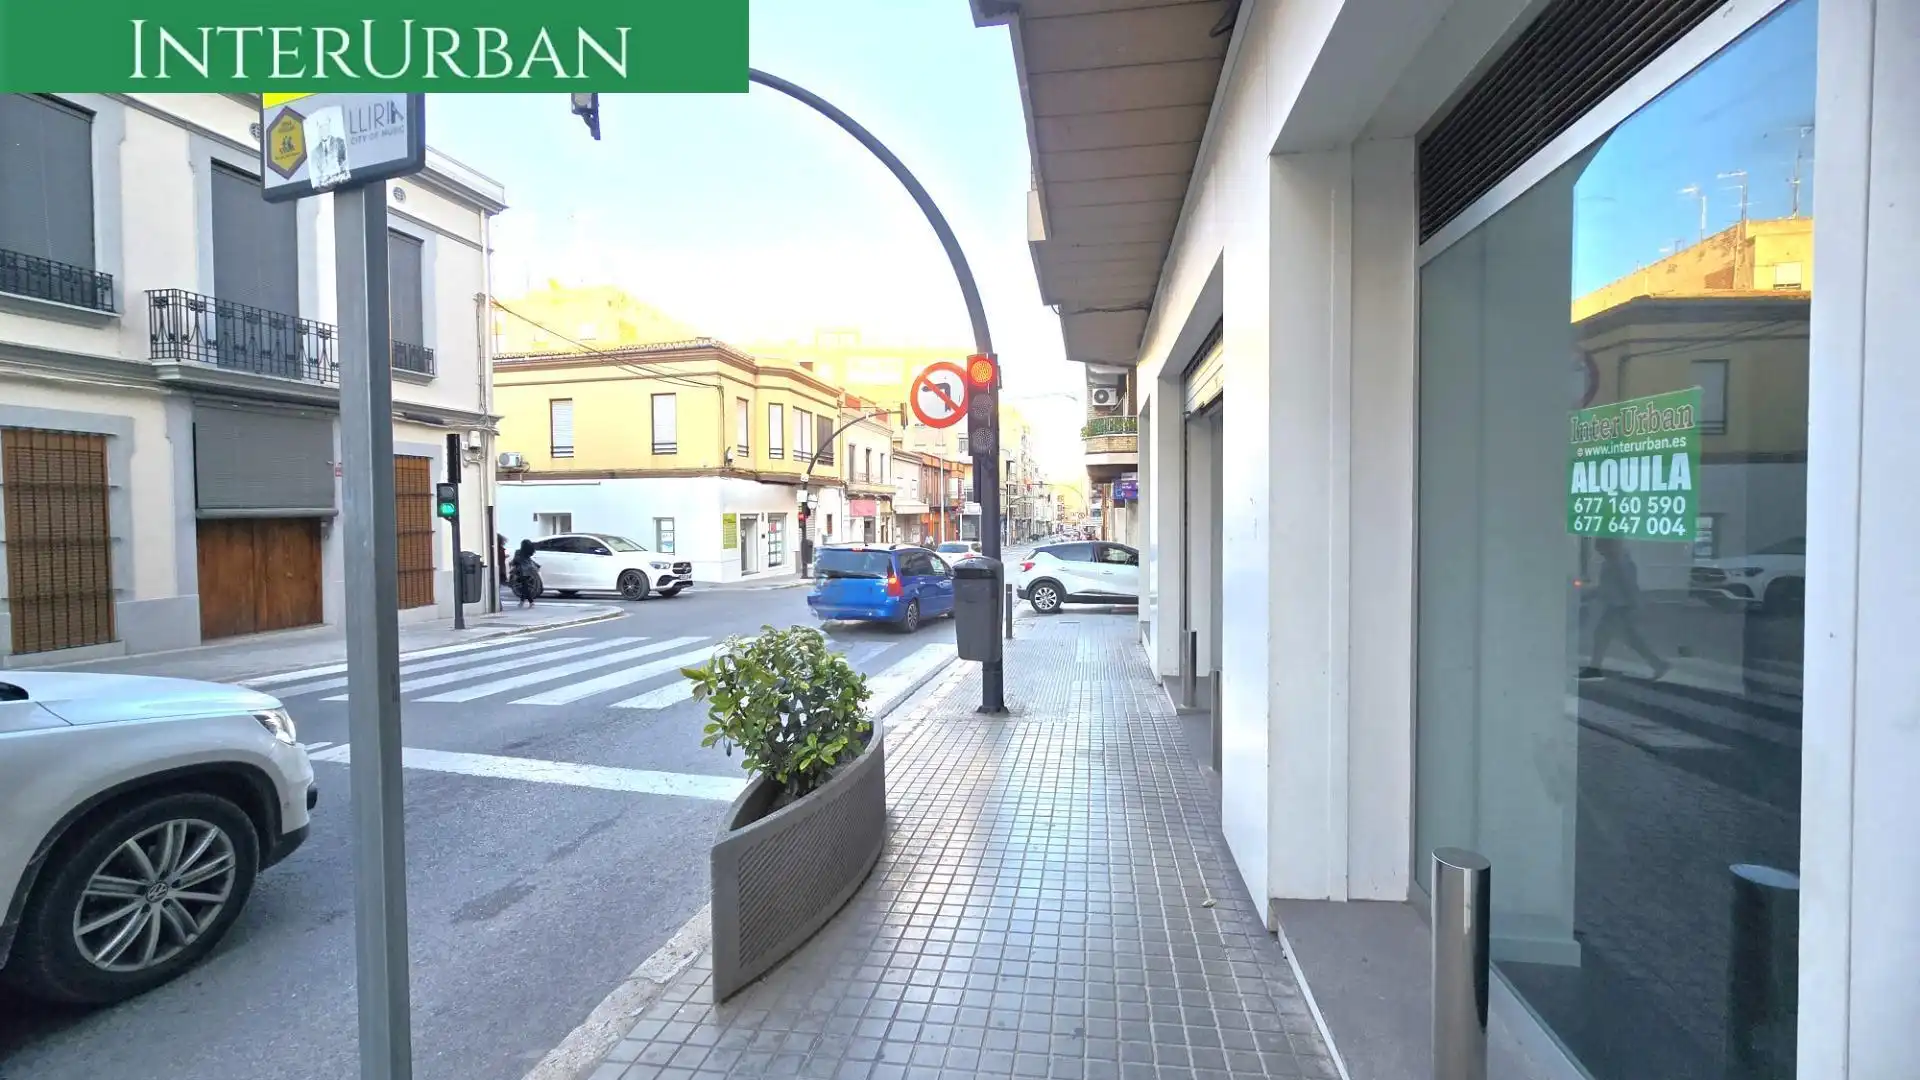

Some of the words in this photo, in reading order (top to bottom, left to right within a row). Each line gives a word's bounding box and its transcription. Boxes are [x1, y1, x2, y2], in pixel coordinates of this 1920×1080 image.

[1584, 436, 1687, 457] www.interurban.es
[1571, 452, 1692, 496] ALQUILA
[1574, 497, 1603, 514] 677
[1608, 497, 1641, 514] 160
[1647, 496, 1686, 515] 590
[1574, 516, 1603, 532] 677
[1608, 516, 1640, 534] 647
[1646, 517, 1686, 536] 004
